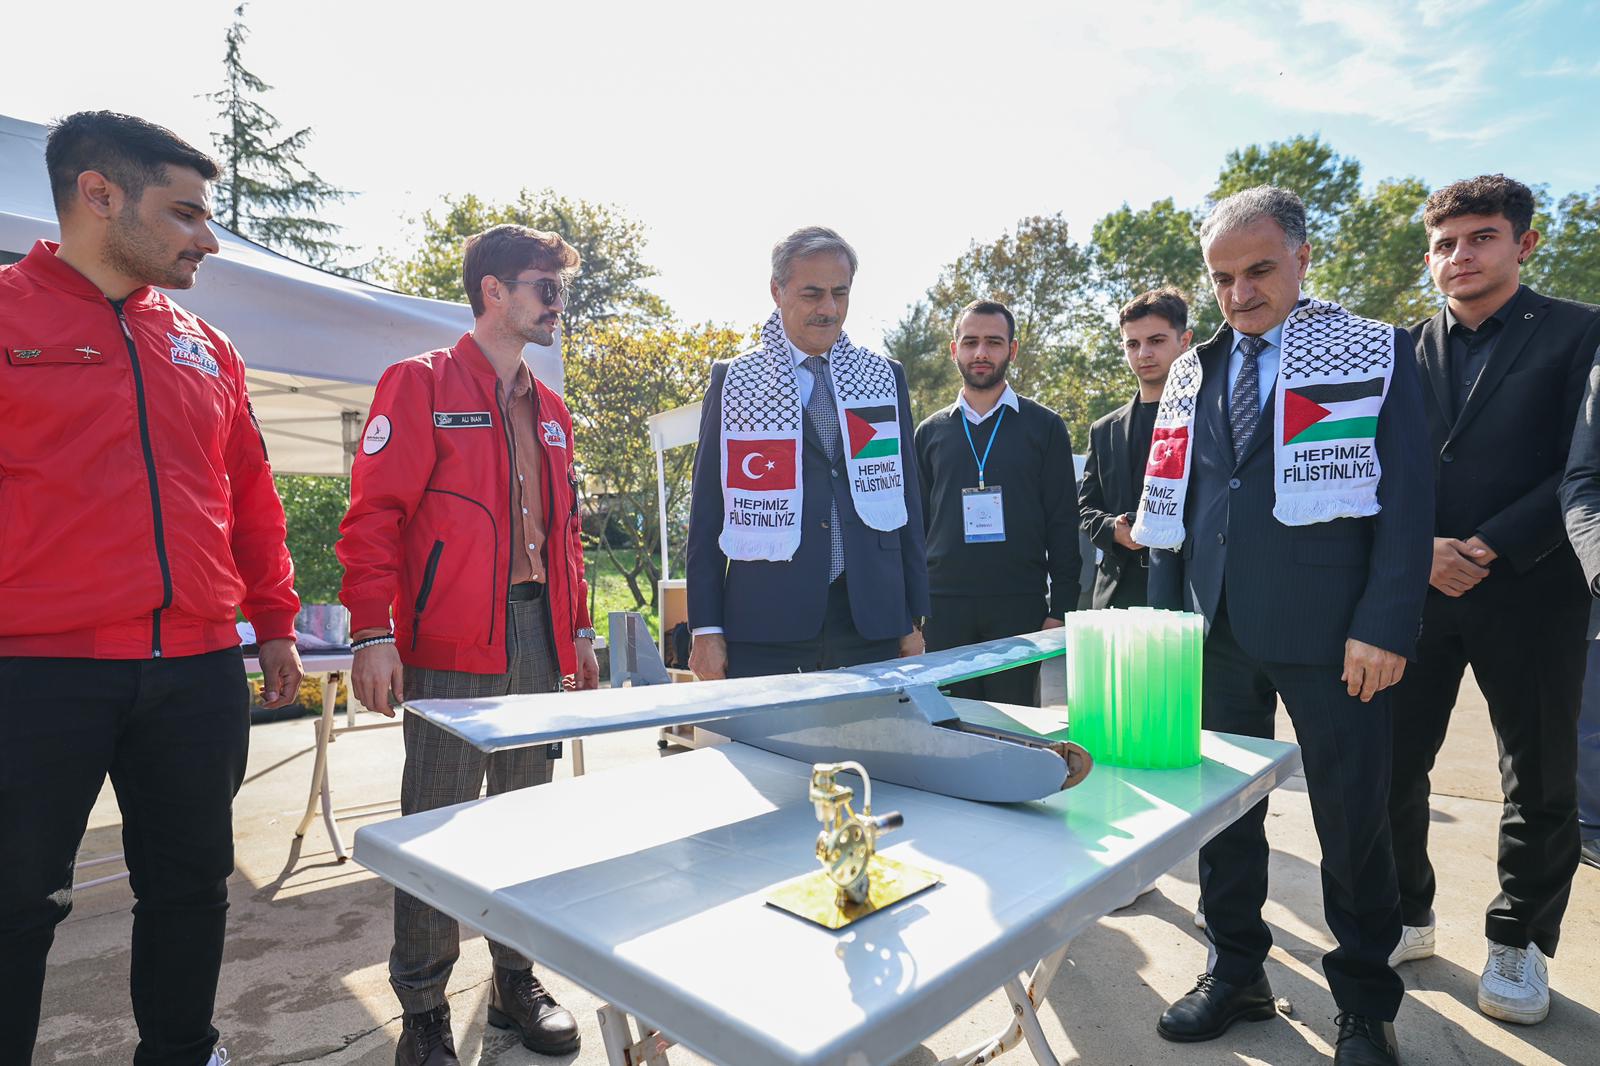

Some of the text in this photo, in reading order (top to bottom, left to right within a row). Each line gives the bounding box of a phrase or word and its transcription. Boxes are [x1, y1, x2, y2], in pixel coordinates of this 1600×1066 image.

[1294, 444, 1371, 463] HEPİMİZ
[858, 461, 896, 476] HEPİMİZ
[1283, 460, 1377, 484] FİLİSTİNLİYİZ
[1144, 483, 1176, 500] PİMİZ
[733, 497, 789, 511] HEPİMİZ
[729, 509, 796, 528] FİLİSTİNLİYİZ
